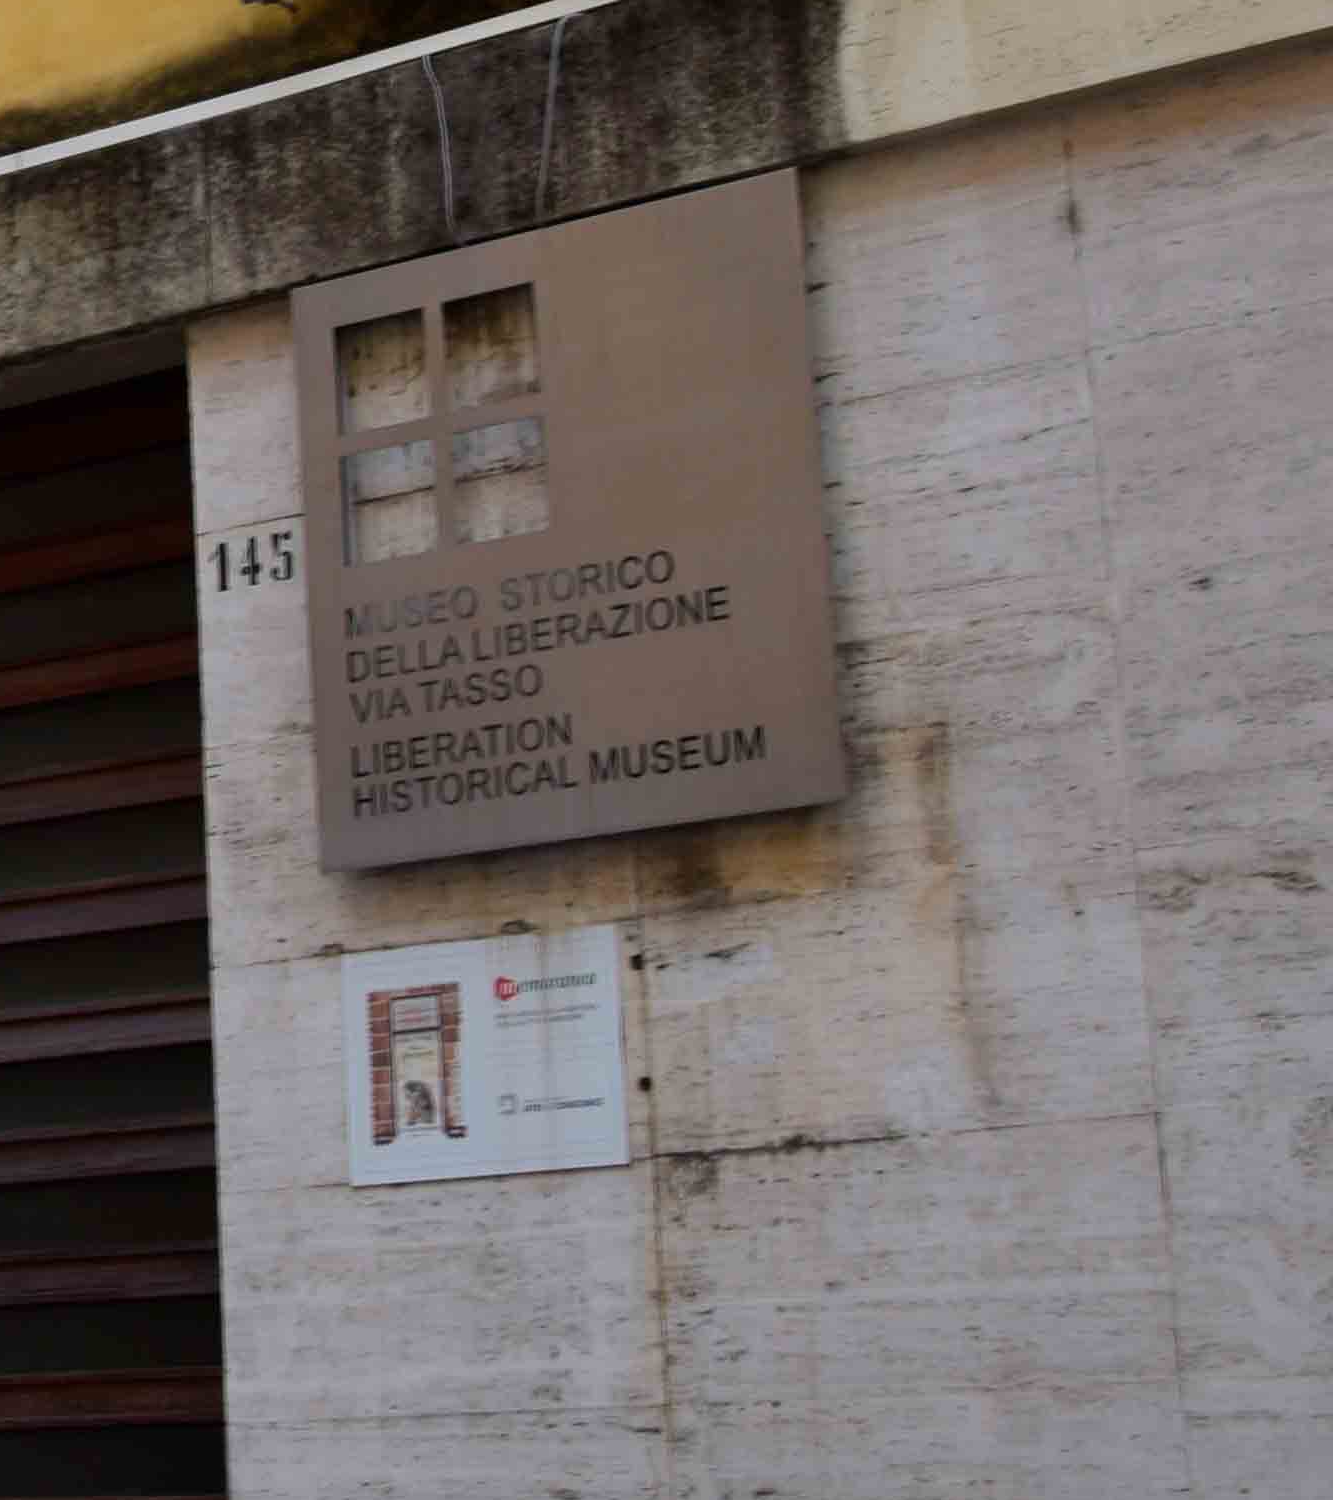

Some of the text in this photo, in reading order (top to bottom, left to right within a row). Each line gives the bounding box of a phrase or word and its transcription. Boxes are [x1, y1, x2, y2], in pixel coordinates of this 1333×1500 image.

[208, 531, 295, 593] 145
[345, 549, 676, 640] MUSEO STORICO
[346, 585, 732, 685] DELLA LIBERAZIONE
[348, 663, 544, 725] VIA TASSO
[349, 713, 574, 780] LIBERATION
[351, 725, 766, 818] HISTORICAL MUSEUM
